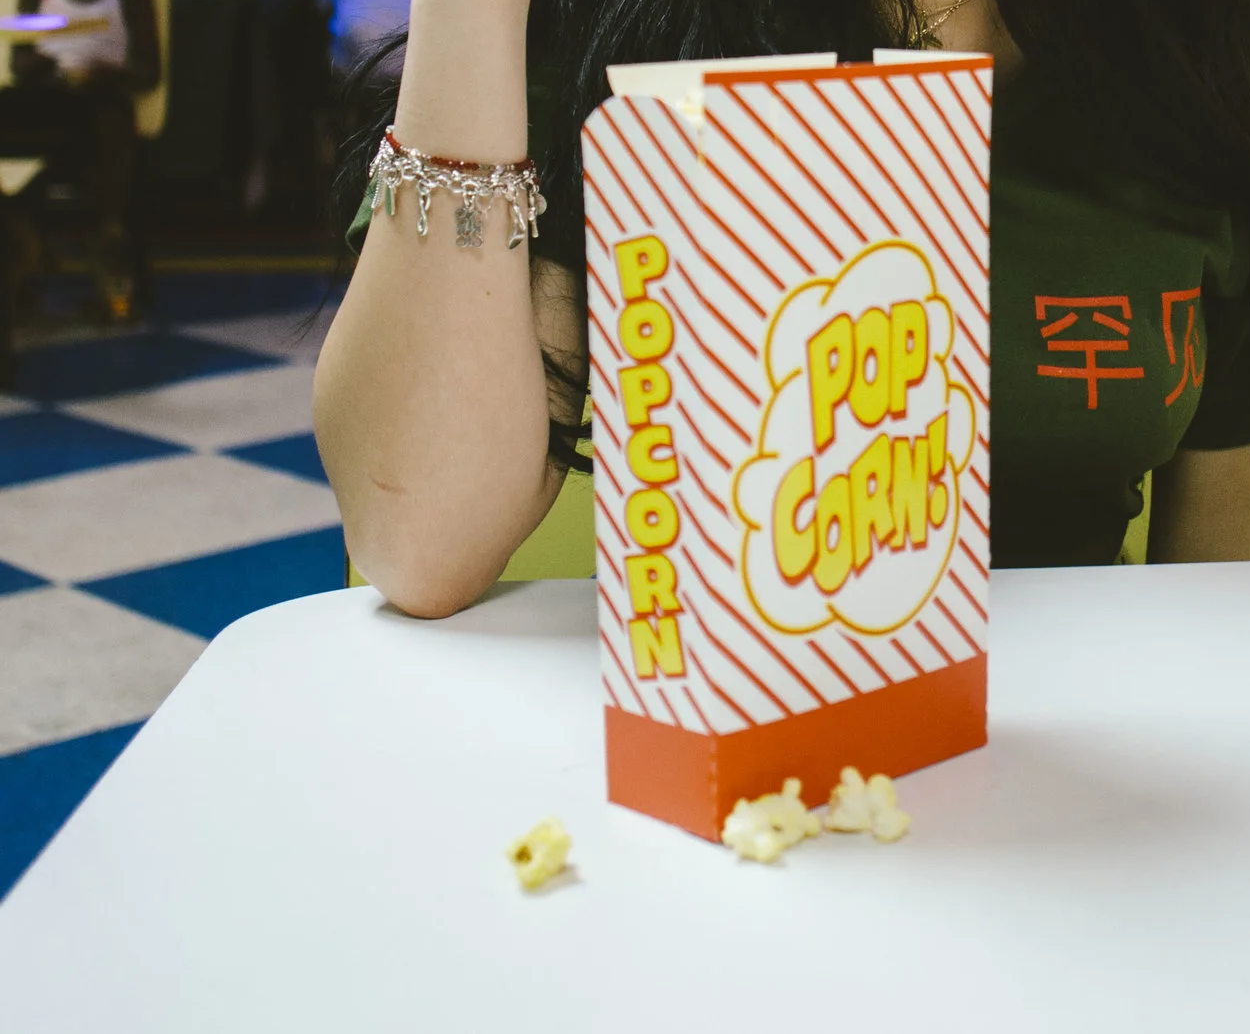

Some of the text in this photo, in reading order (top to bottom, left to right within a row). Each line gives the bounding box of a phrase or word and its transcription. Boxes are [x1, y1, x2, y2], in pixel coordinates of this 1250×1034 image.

[613, 235, 688, 681] POPCORN
[806, 299, 930, 456] POP
[771, 409, 949, 597] CORN!
